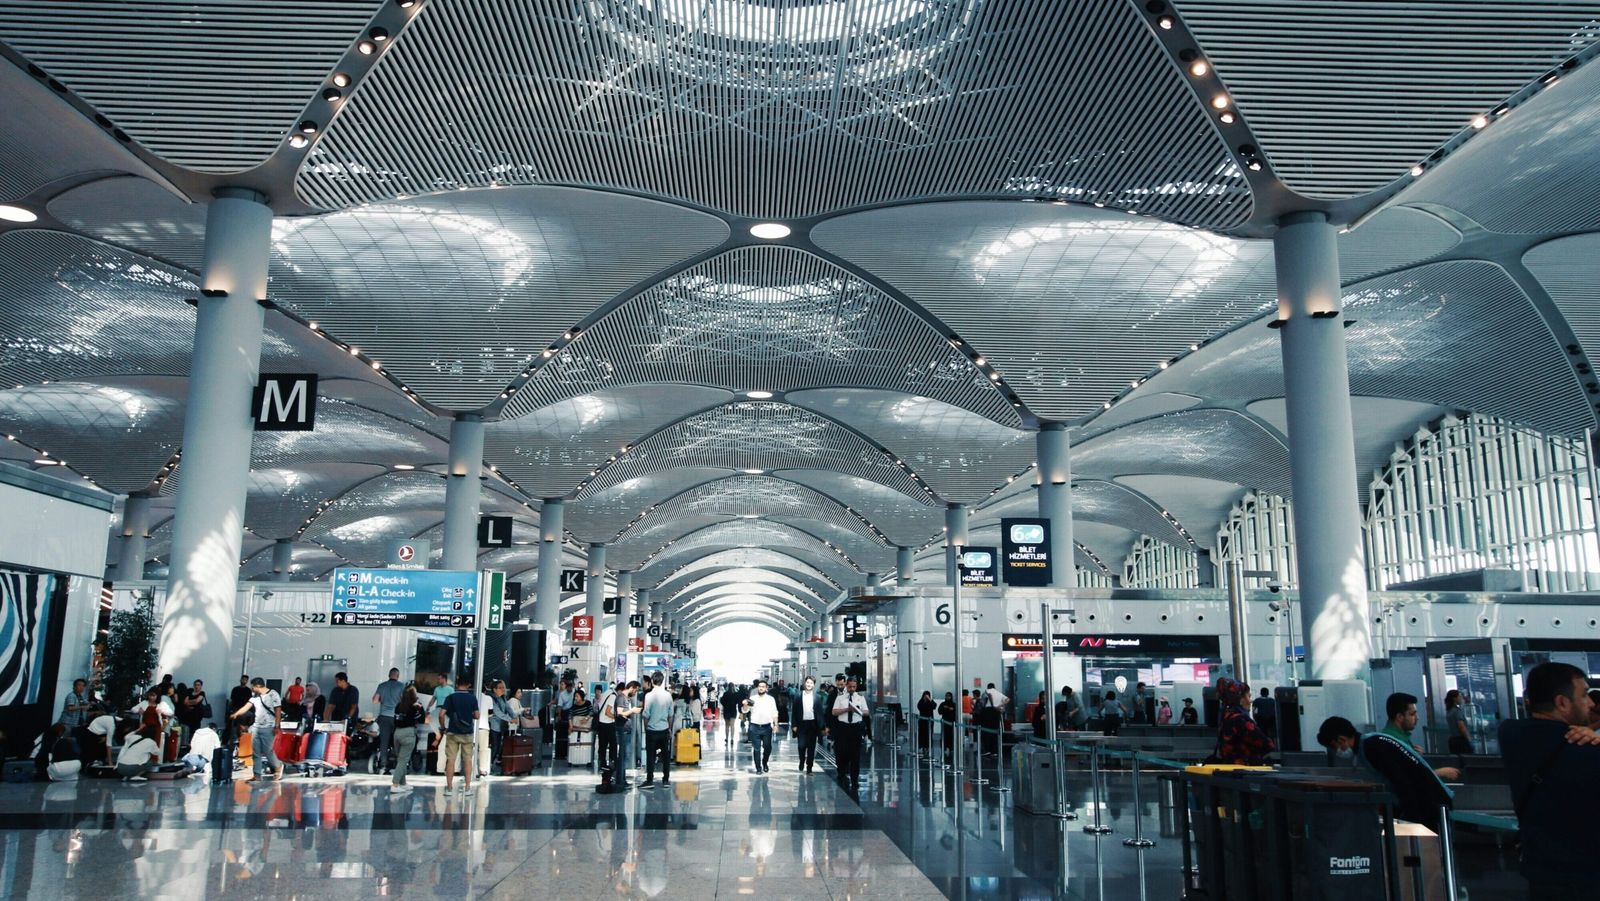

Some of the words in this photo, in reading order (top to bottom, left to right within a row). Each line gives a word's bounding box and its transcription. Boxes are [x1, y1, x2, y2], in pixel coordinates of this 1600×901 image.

[260, 380, 307, 422] M
[488, 520, 502, 544] L
[1014, 527, 1024, 540] 6
[360, 573, 371, 584] M
[374, 576, 408, 584] Check-in
[566, 572, 578, 589] K
[359, 586, 378, 596] L-A
[381, 589, 415, 597] Check-in
[609, 599, 616, 612] J
[300, 613, 326, 623] 1-22
[936, 604, 950, 624] 6
[633, 616, 642, 627] H
[651, 626, 658, 636] G
[570, 648, 579, 658] K
[822, 650, 828, 659] 5
